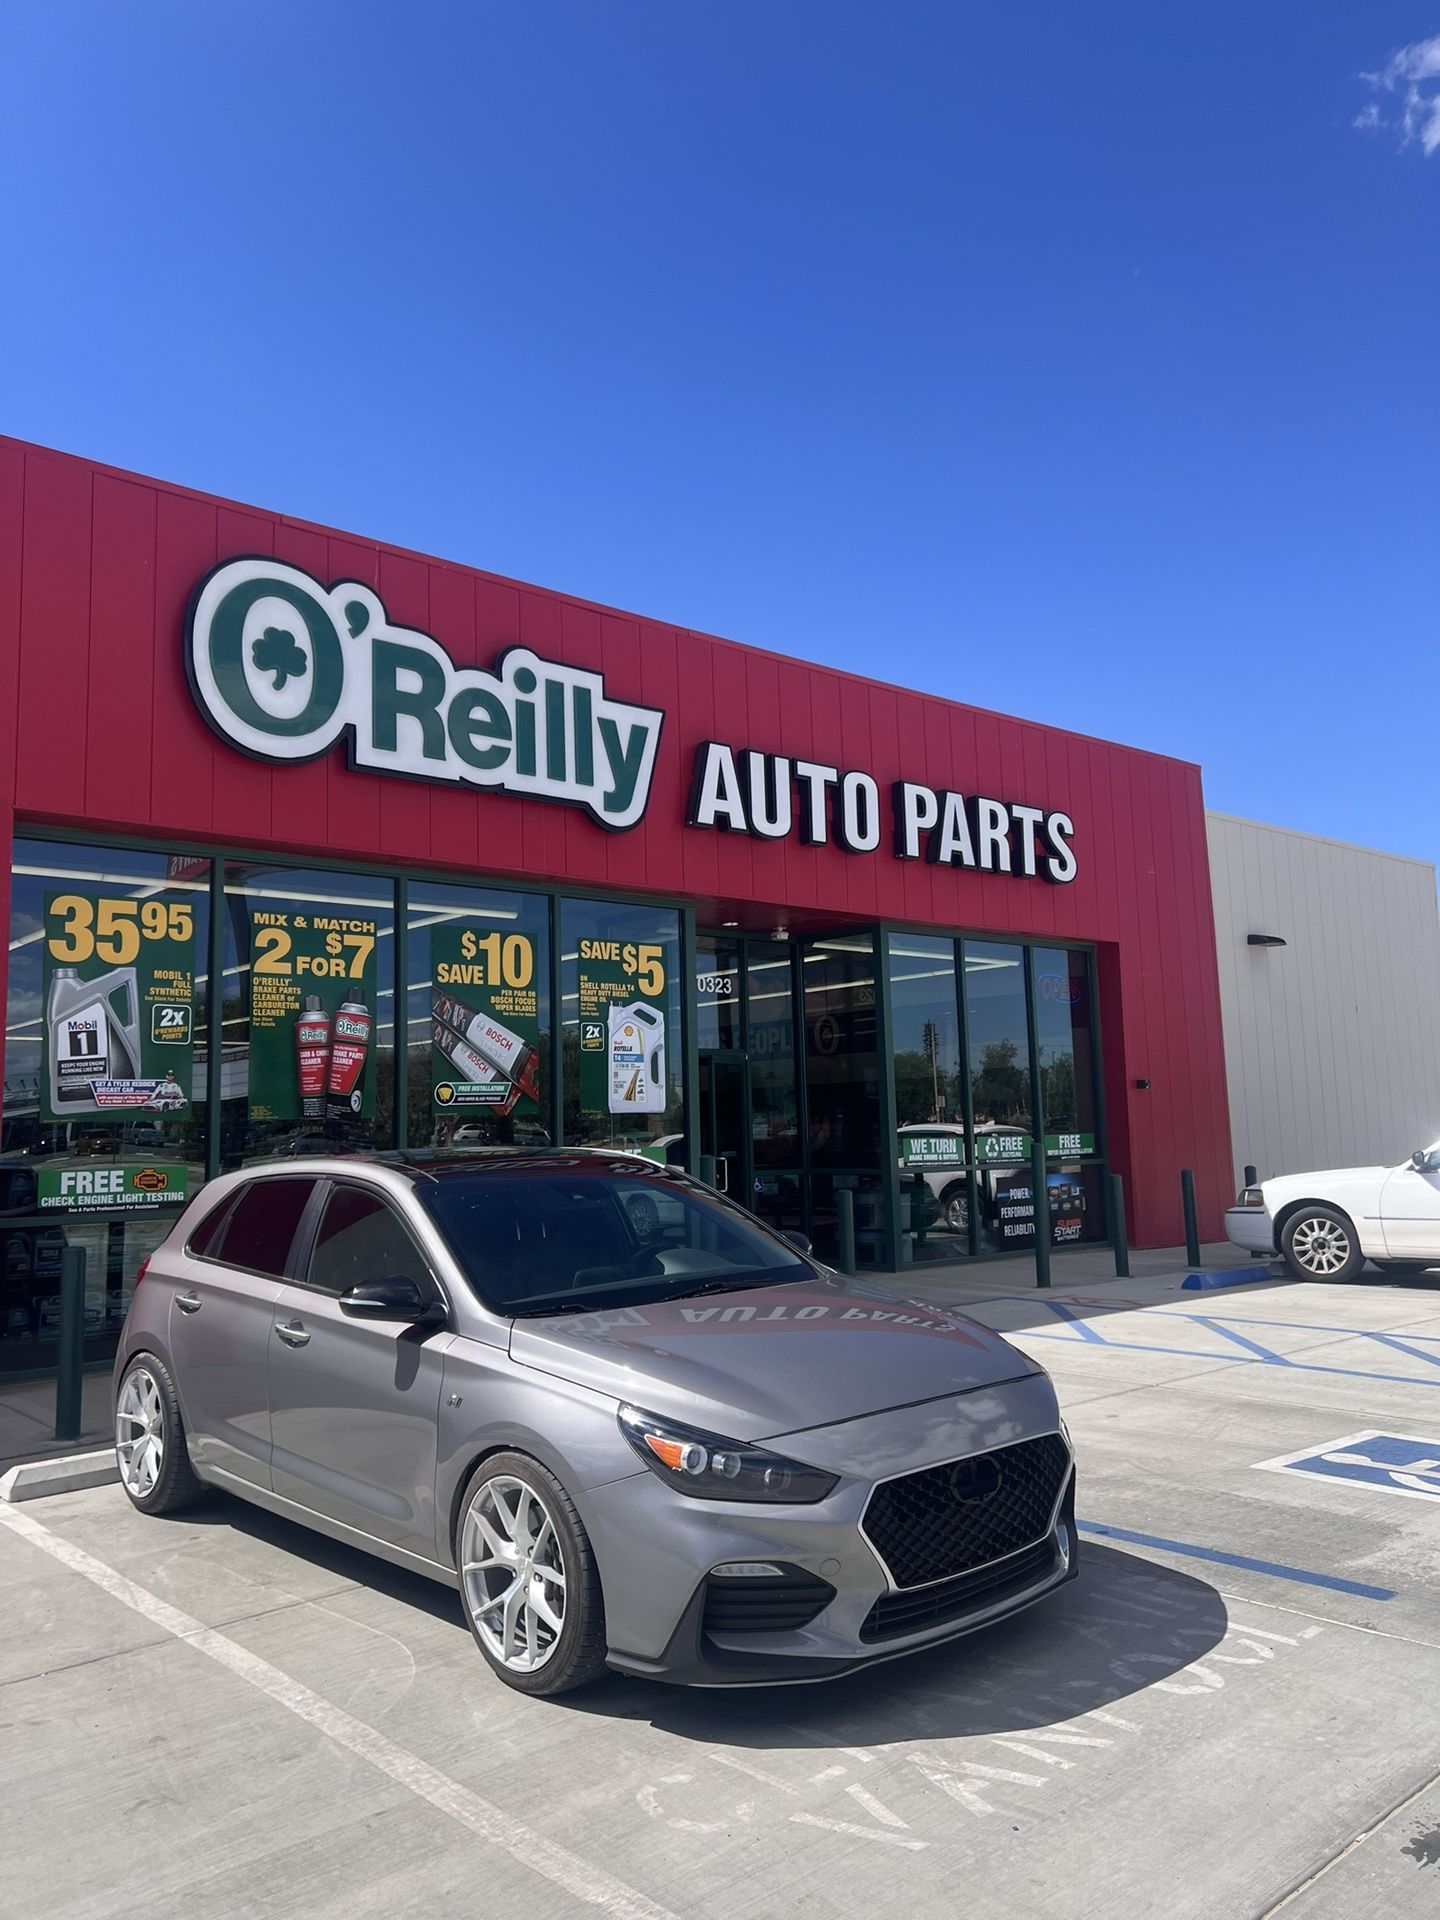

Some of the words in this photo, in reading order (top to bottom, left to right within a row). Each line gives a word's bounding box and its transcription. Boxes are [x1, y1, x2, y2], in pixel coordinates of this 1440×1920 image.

[208, 577, 649, 813] O'Reilly
[696, 742, 880, 851] AUTO
[903, 782, 1078, 883] PARTS
[253, 912, 288, 927] MIX
[294, 916, 307, 928] &
[313, 917, 375, 933] MATCH
[253, 927, 292, 975] 2
[296, 956, 346, 977] FOR
[437, 962, 484, 985] SAVE
[461, 930, 533, 988] $10
[154, 970, 182, 981] MOBIL
[186, 972, 191, 981] 1
[580, 940, 620, 960] SAVE
[622, 943, 665, 996] $5
[149, 987, 192, 997] SYNTHETIC
[173, 980, 191, 989] FULL
[253, 986, 278, 994] BRAKE
[279, 987, 302, 995] PARTS
[580, 982, 599, 990] SHELL
[600, 983, 626, 991] ROTELLA
[627, 984, 635, 992] T4
[697, 977, 732, 994] 0323
[253, 993, 285, 1001] CLEANER
[490, 996, 513, 1004] BOSCH
[515, 997, 536, 1005] FOCUS
[253, 1001, 300, 1010] CARBURETOR
[68, 1020, 97, 1030] Mobil
[160, 1008, 185, 1027] 2x
[336, 1017, 369, 1039] O'Reilly
[585, 1025, 600, 1039] 2x
[77, 1032, 89, 1055] 1
[485, 1027, 513, 1051] BOSCH
[467, 1051, 489, 1074] BOSCH
[910, 1138, 928, 1154] WE
[929, 1138, 957, 1153] TURN
[999, 1136, 1023, 1151] FREE
[1059, 1134, 1081, 1149] FREE
[60, 1170, 124, 1195] FREE
[41, 1197, 75, 1207] CHECK
[77, 1195, 113, 1206] ENGINE
[116, 1193, 144, 1203] LIGHT
[145, 1191, 184, 1202] TESTING
[1000, 1205, 1035, 1219] PERFORMAN
[1054, 1224, 1082, 1237] START
